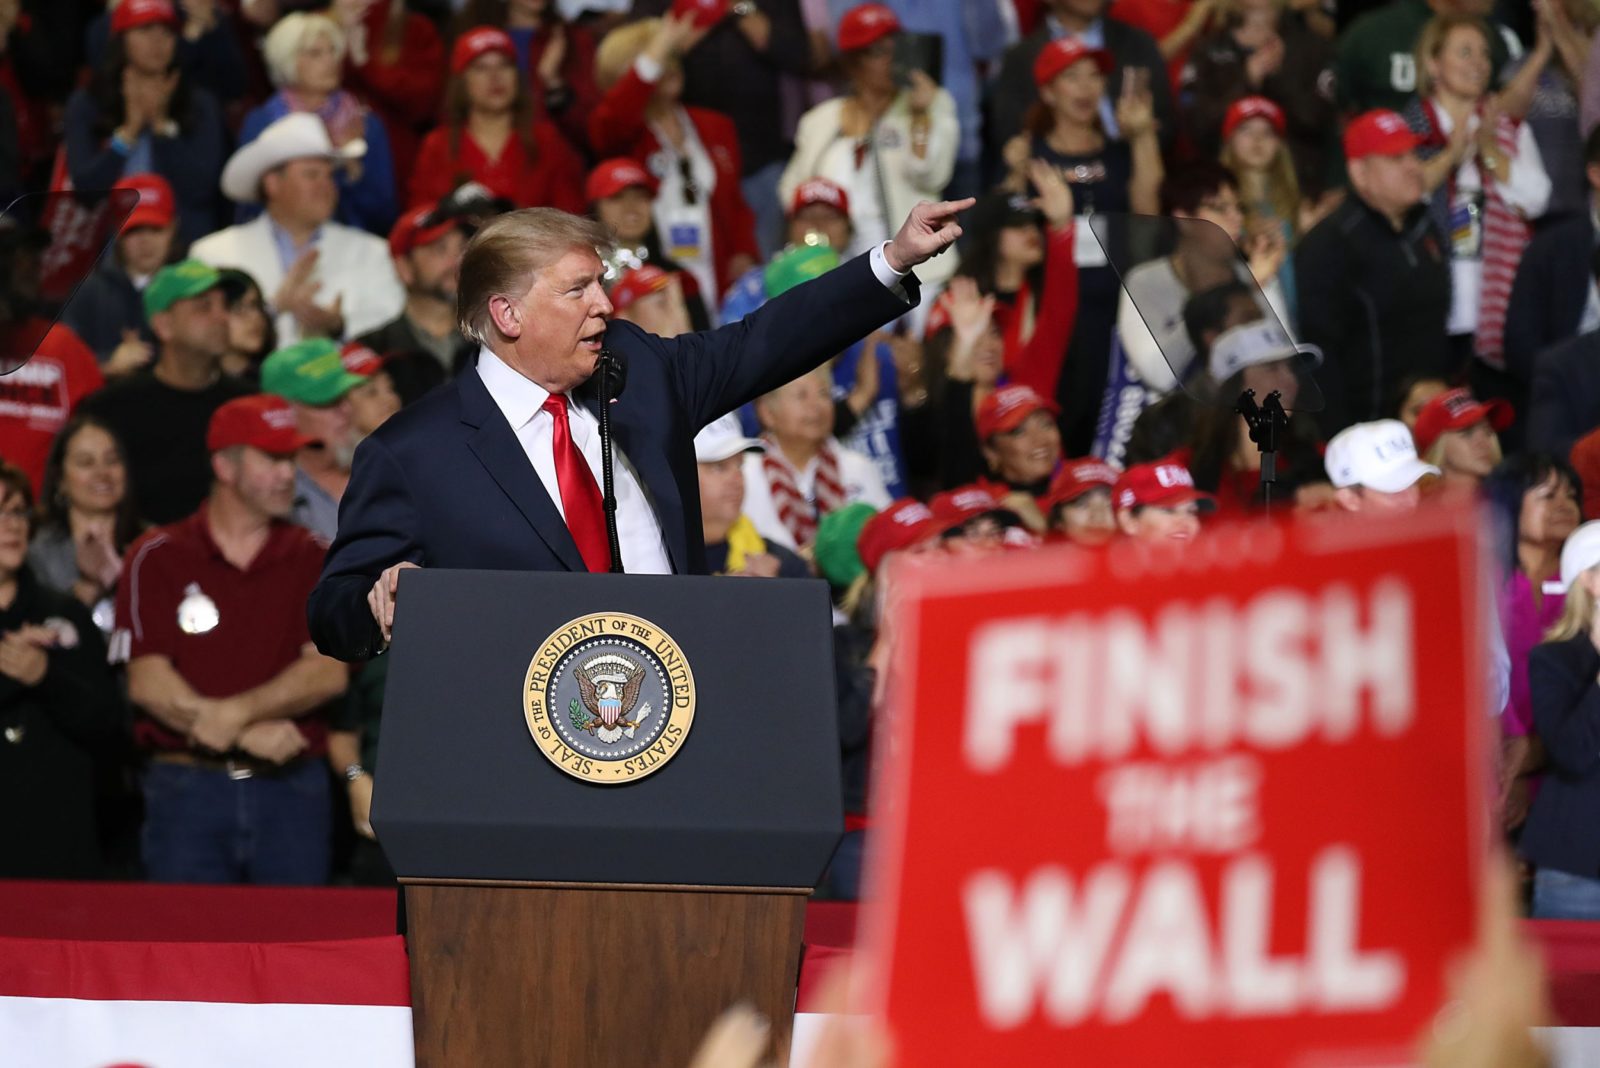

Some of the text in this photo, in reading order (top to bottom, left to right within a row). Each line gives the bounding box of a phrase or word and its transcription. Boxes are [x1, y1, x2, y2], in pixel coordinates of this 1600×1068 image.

[611, 620, 627, 631] OF
[630, 623, 652, 640] THE
[530, 618, 606, 693] PRESIDENT
[655, 638, 690, 708] UNITED
[965, 580, 1411, 770] FINISH
[531, 699, 544, 722] THE
[538, 725, 551, 740] OF
[550, 739, 593, 775] SEAL
[624, 724, 682, 775] STATES
[1104, 756, 1260, 853] THE
[964, 848, 1400, 1030] WALL
